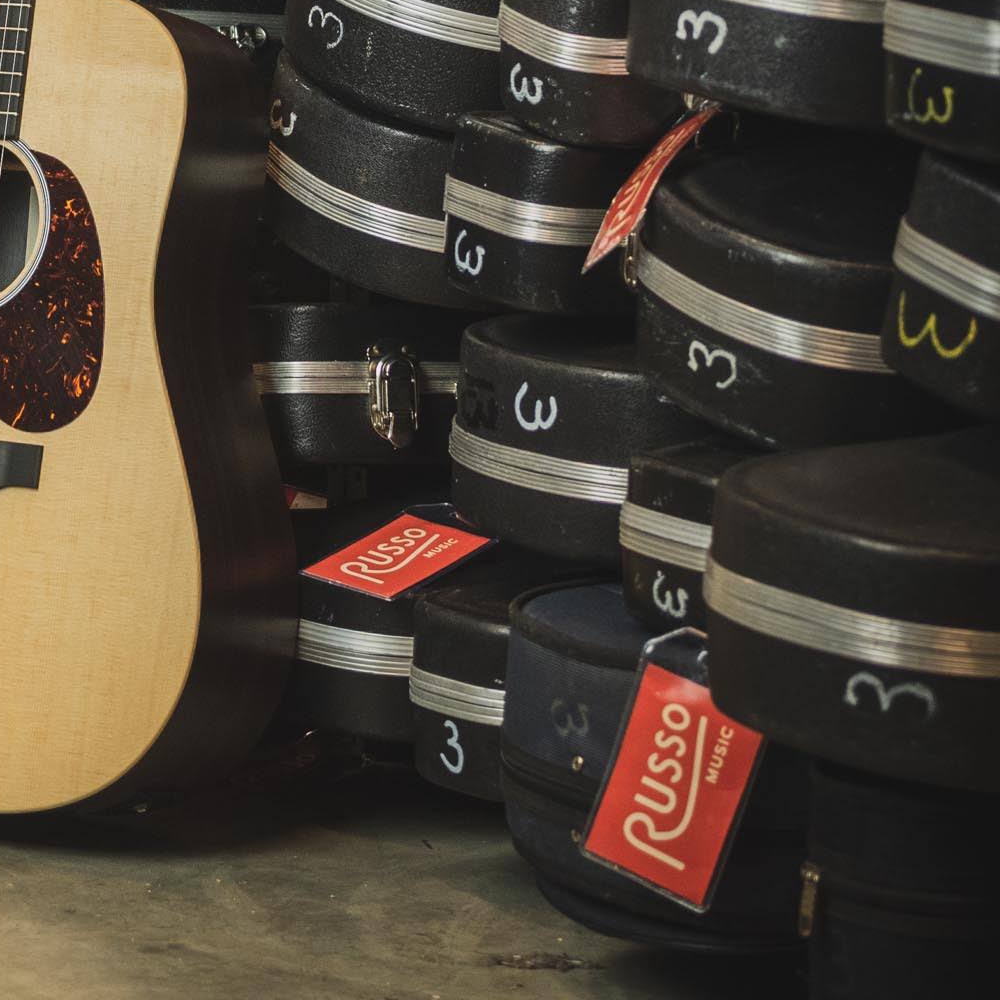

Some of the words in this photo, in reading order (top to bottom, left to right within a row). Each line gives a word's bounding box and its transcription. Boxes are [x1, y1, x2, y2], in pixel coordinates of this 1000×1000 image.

[308, 6, 344, 48] 3
[677, 9, 726, 54] 3
[510, 63, 542, 104] 3
[908, 68, 953, 124] 3
[270, 99, 297, 136] 3
[455, 228, 484, 275] 3
[898, 292, 976, 358] 3
[688, 340, 737, 388] 3
[515, 382, 557, 430] 3
[340, 528, 440, 584] RUSSO
[423, 538, 459, 558] MUSIC
[653, 570, 686, 618] 3
[845, 671, 935, 718] 3
[440, 720, 464, 774] 3
[705, 725, 735, 784] MUSIC
[623, 703, 708, 871] RUSSO
